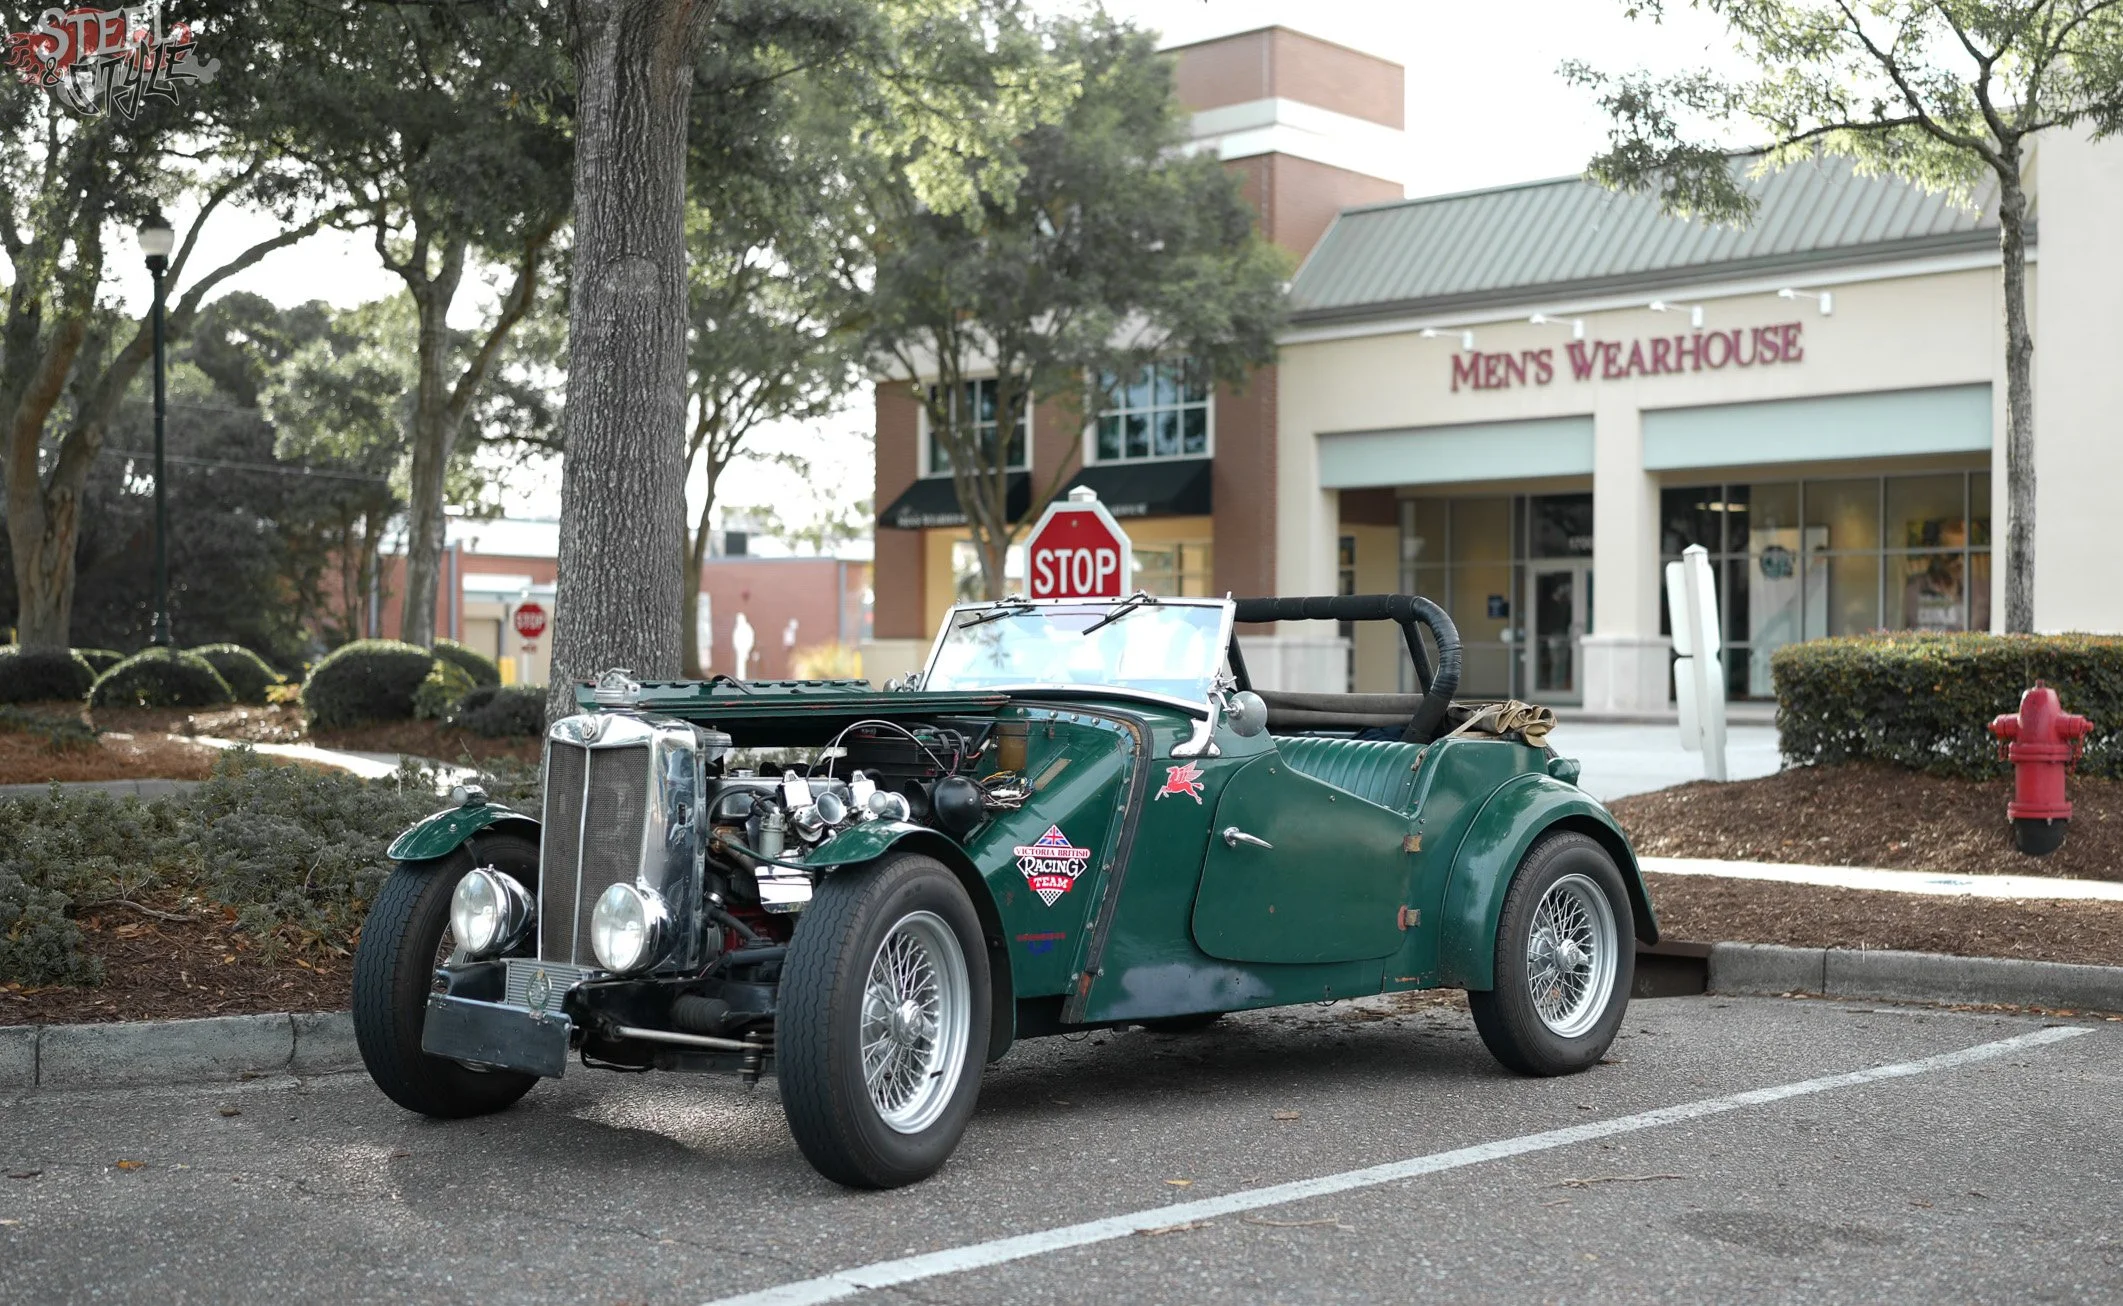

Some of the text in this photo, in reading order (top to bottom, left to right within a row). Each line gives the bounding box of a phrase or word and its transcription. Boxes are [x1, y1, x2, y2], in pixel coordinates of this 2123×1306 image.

[1451, 322, 1804, 392] MEN'S WEARHOUSE
[1034, 548, 1117, 595] STOP
[516, 612, 544, 630] STOP
[1016, 848, 1088, 857] VICTORIA BRITISH
[1024, 856, 1079, 877] RACING
[1034, 877, 1069, 889] TEAM
